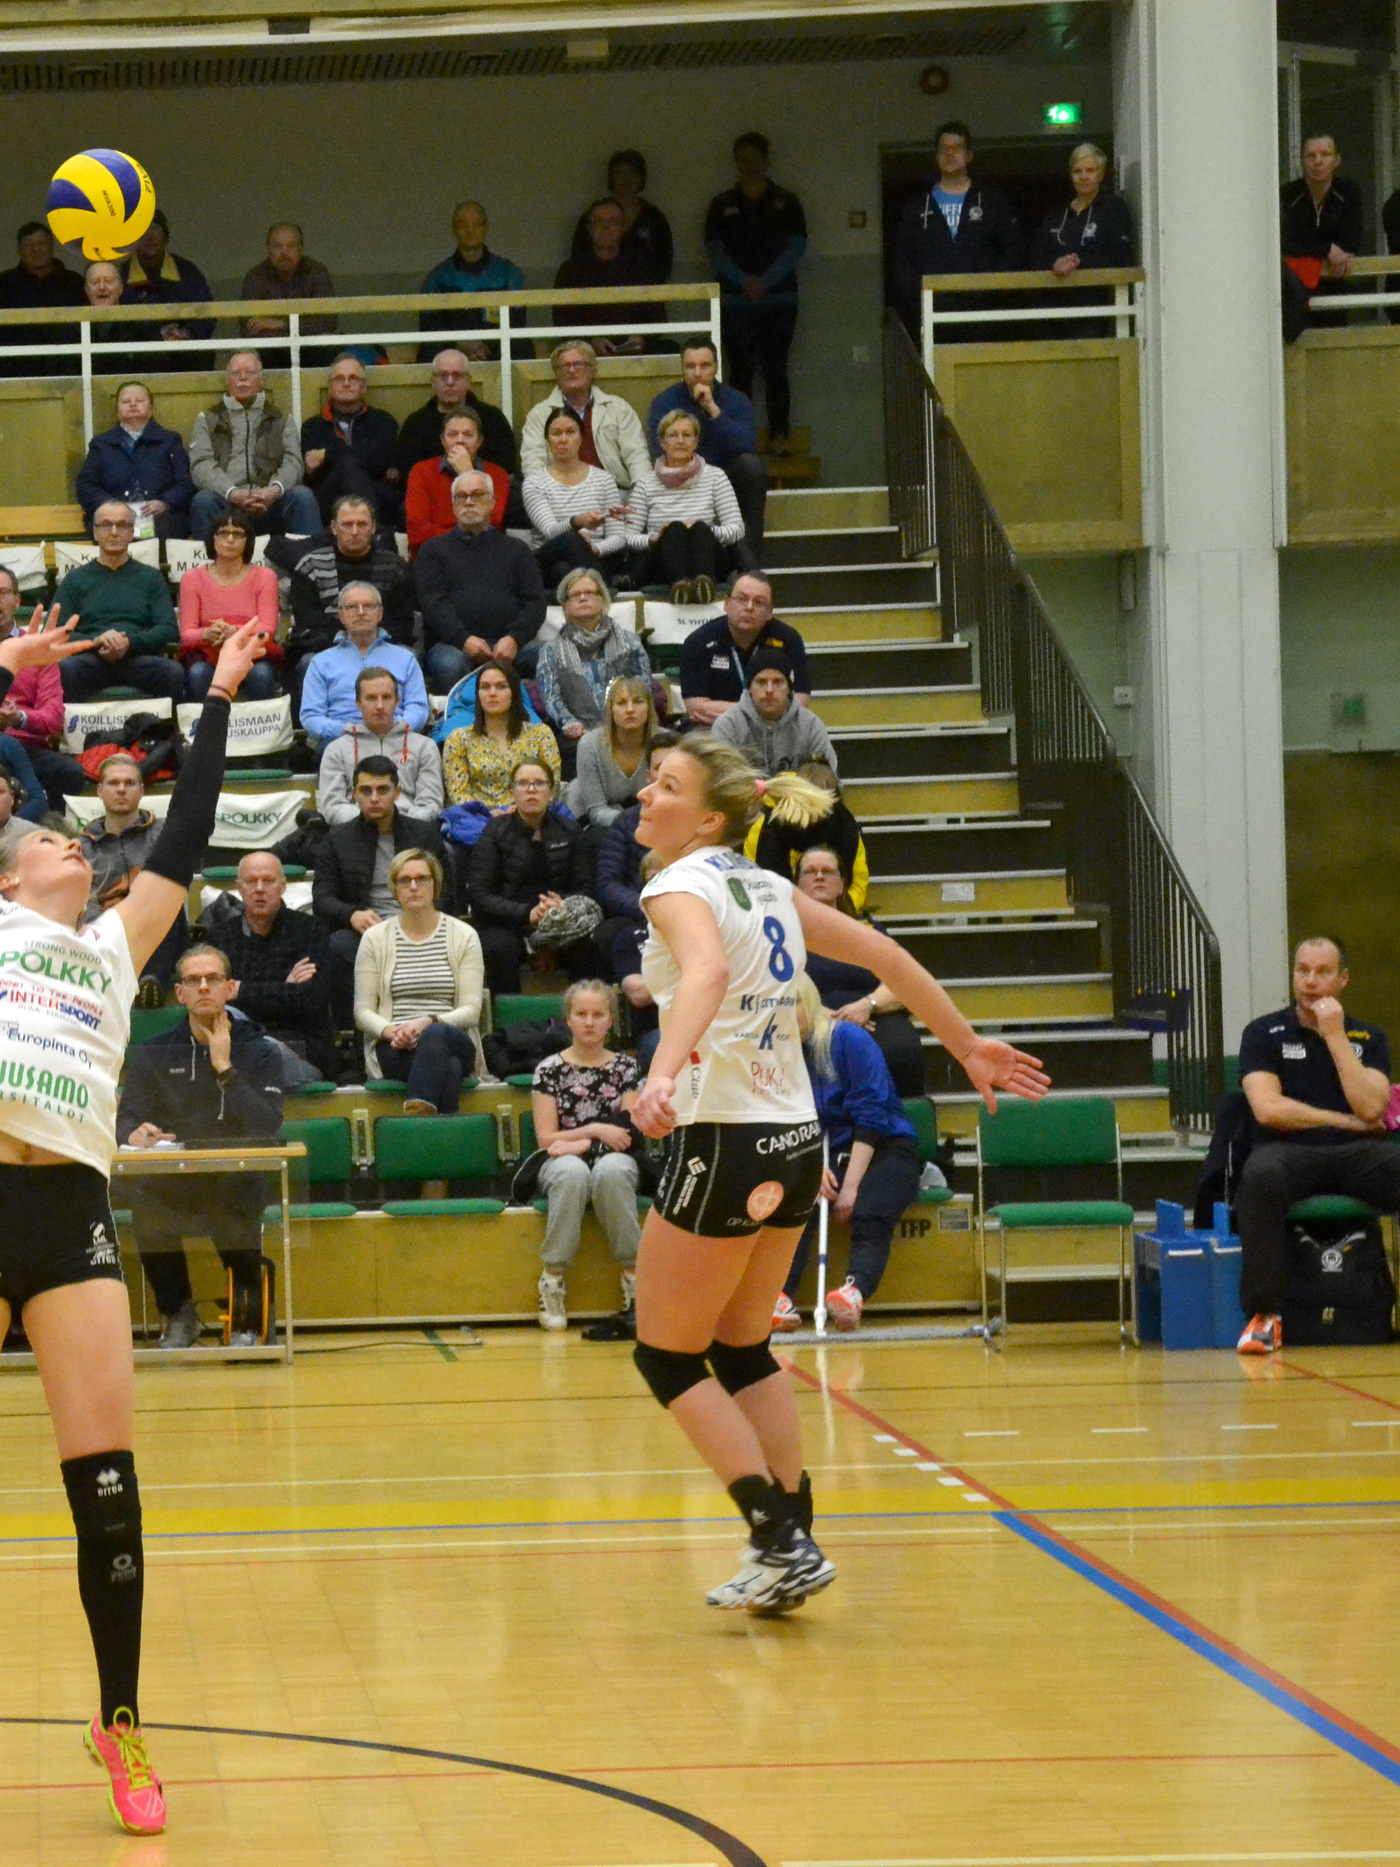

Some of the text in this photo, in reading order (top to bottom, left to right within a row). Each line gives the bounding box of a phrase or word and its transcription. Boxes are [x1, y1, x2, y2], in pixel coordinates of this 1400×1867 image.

[763, 916, 795, 983] 8
[9, 988, 102, 1031] INTERSPORT
[8, 1026, 77, 1058] Europinta
